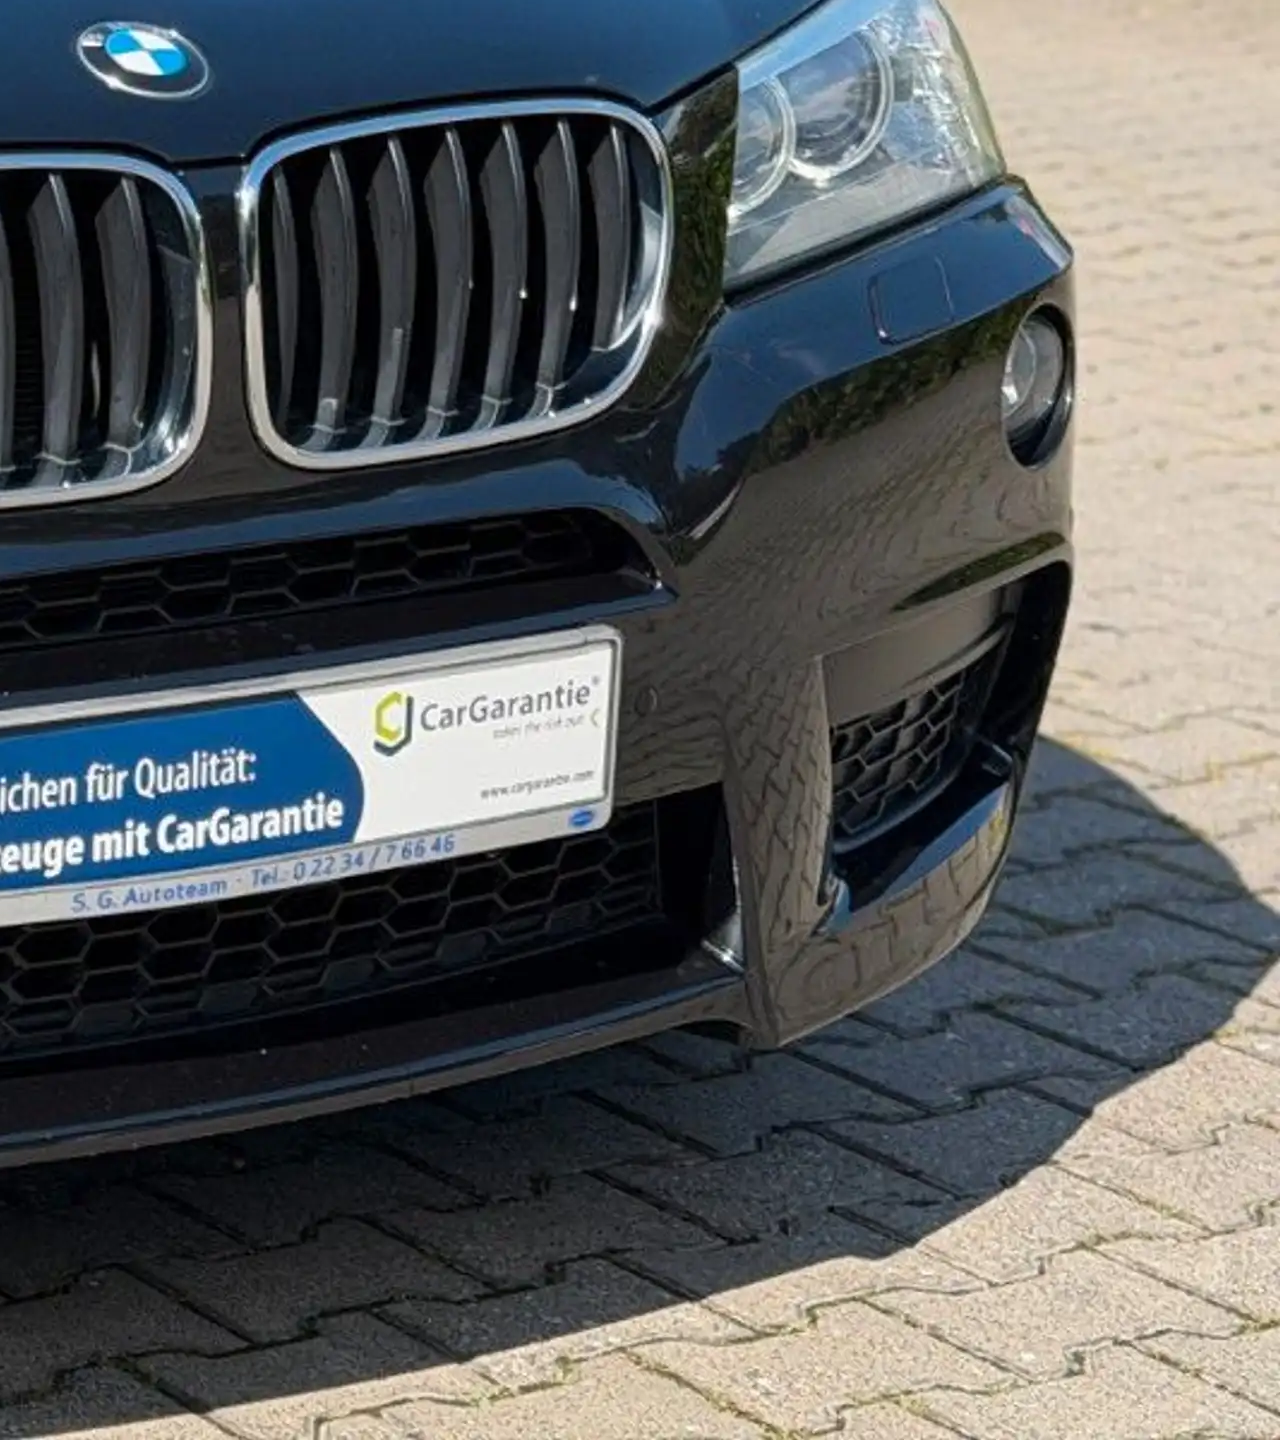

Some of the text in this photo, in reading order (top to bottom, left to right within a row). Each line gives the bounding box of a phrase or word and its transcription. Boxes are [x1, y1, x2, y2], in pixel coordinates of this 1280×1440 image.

[85, 761, 130, 803] für
[133, 746, 257, 800] Qualität:
[91, 818, 152, 863] mit
[156, 791, 345, 854] CarGarantie
[123, 877, 228, 906] Autoteam
